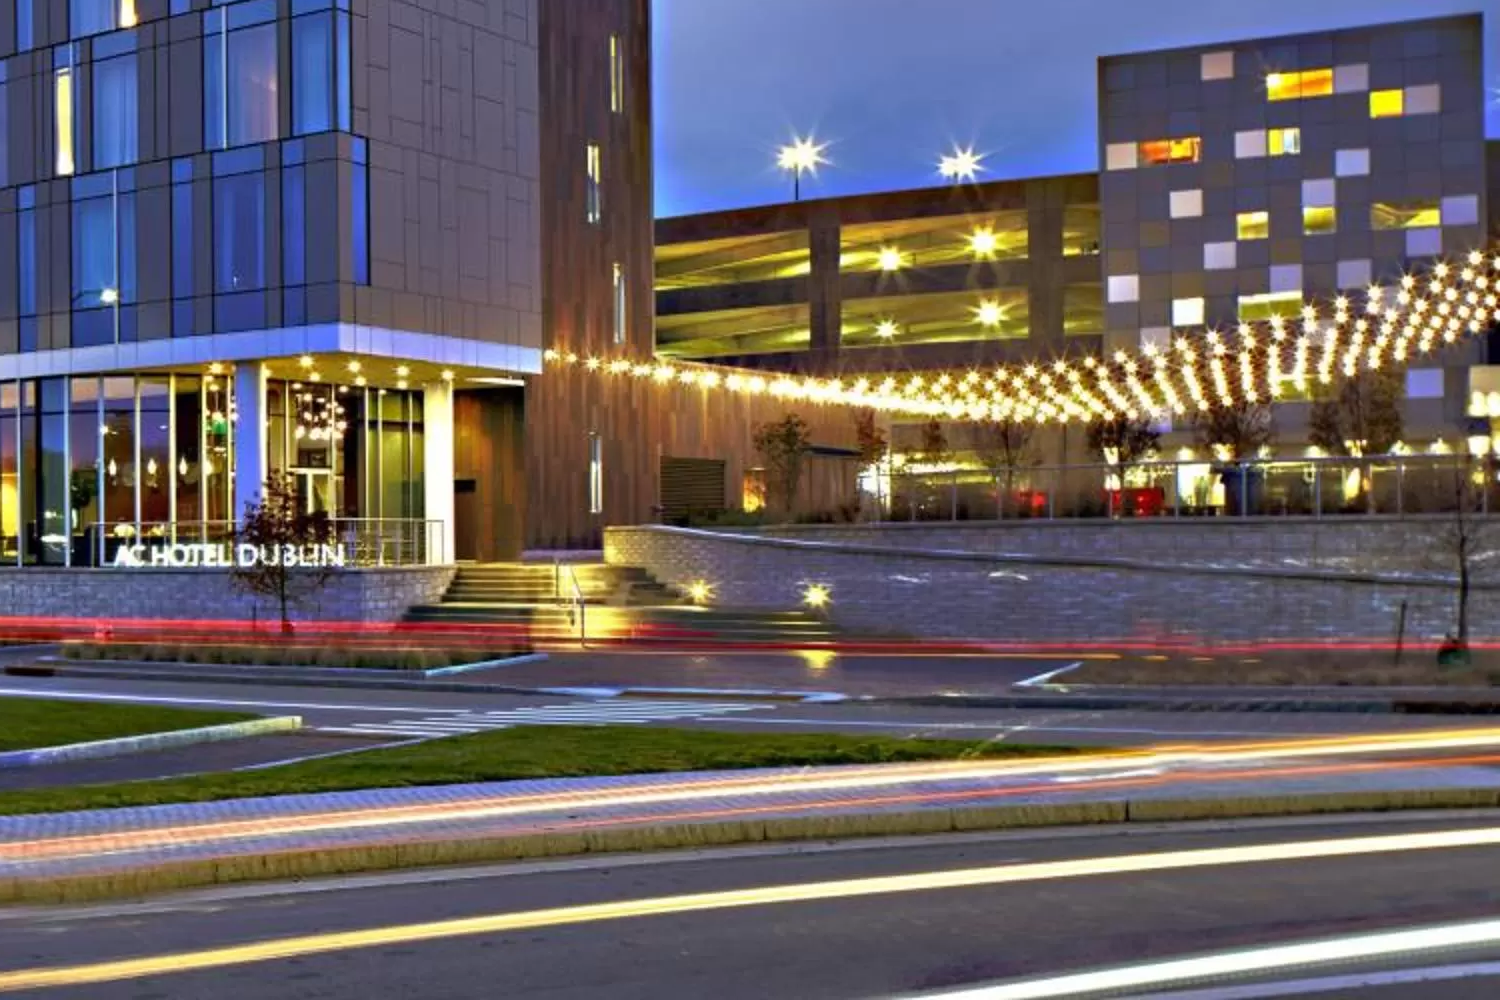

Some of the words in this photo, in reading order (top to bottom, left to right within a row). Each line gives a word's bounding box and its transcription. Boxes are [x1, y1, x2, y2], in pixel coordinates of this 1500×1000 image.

[113, 544, 146, 567] AC
[150, 543, 231, 567] HOTEL
[238, 543, 345, 567] DUBLIN
